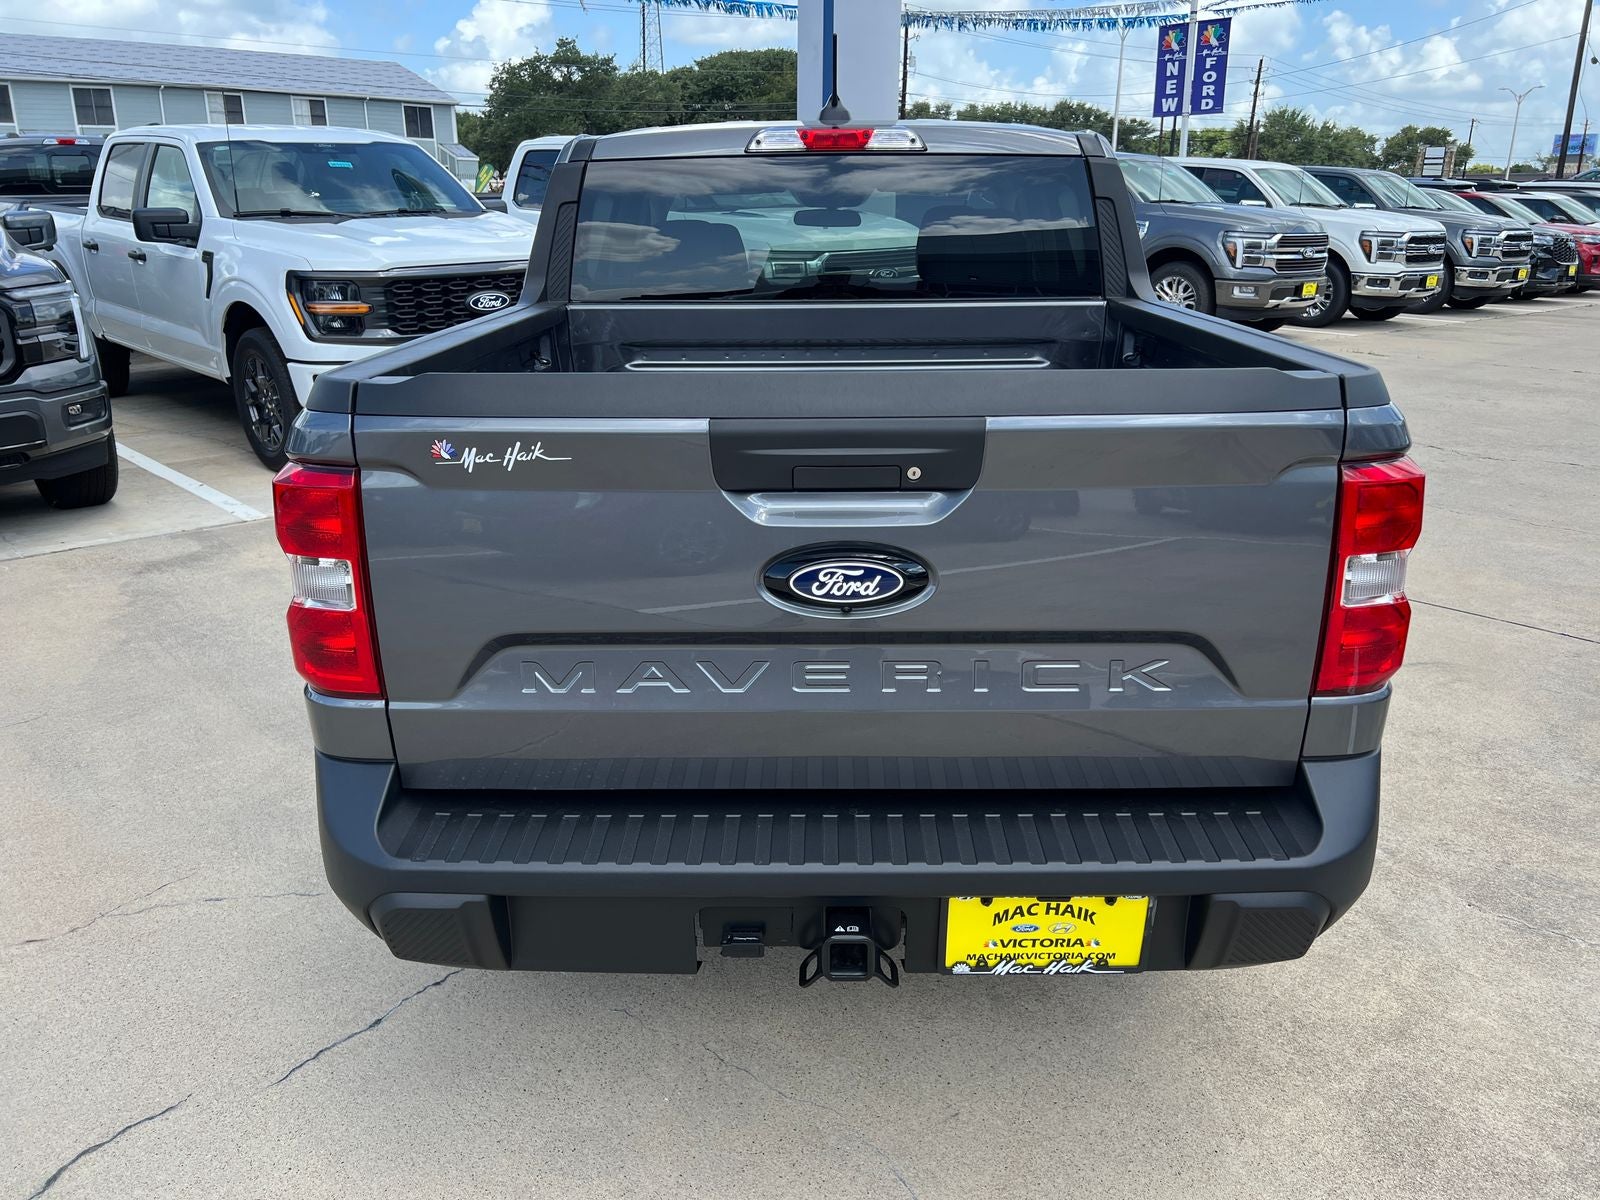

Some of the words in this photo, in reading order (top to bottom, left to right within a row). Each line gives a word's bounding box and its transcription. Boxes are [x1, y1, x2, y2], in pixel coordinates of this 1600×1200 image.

[1161, 61, 1179, 112] NEW
[1200, 57, 1217, 110] FORD
[477, 295, 503, 308] Ford
[456, 446, 501, 473] Mac
[502, 441, 560, 472] Haik
[811, 568, 882, 596] Ford
[519, 658, 1173, 694] MAVERICK
[992, 902, 1040, 927] MAC
[1044, 902, 1097, 926] HAIK
[966, 952, 1117, 961] MACHAIKVICTORIA.COM
[999, 938, 1086, 949] VICTORIA
[986, 959, 1041, 976] Mac
[1042, 959, 1110, 975] Haik
